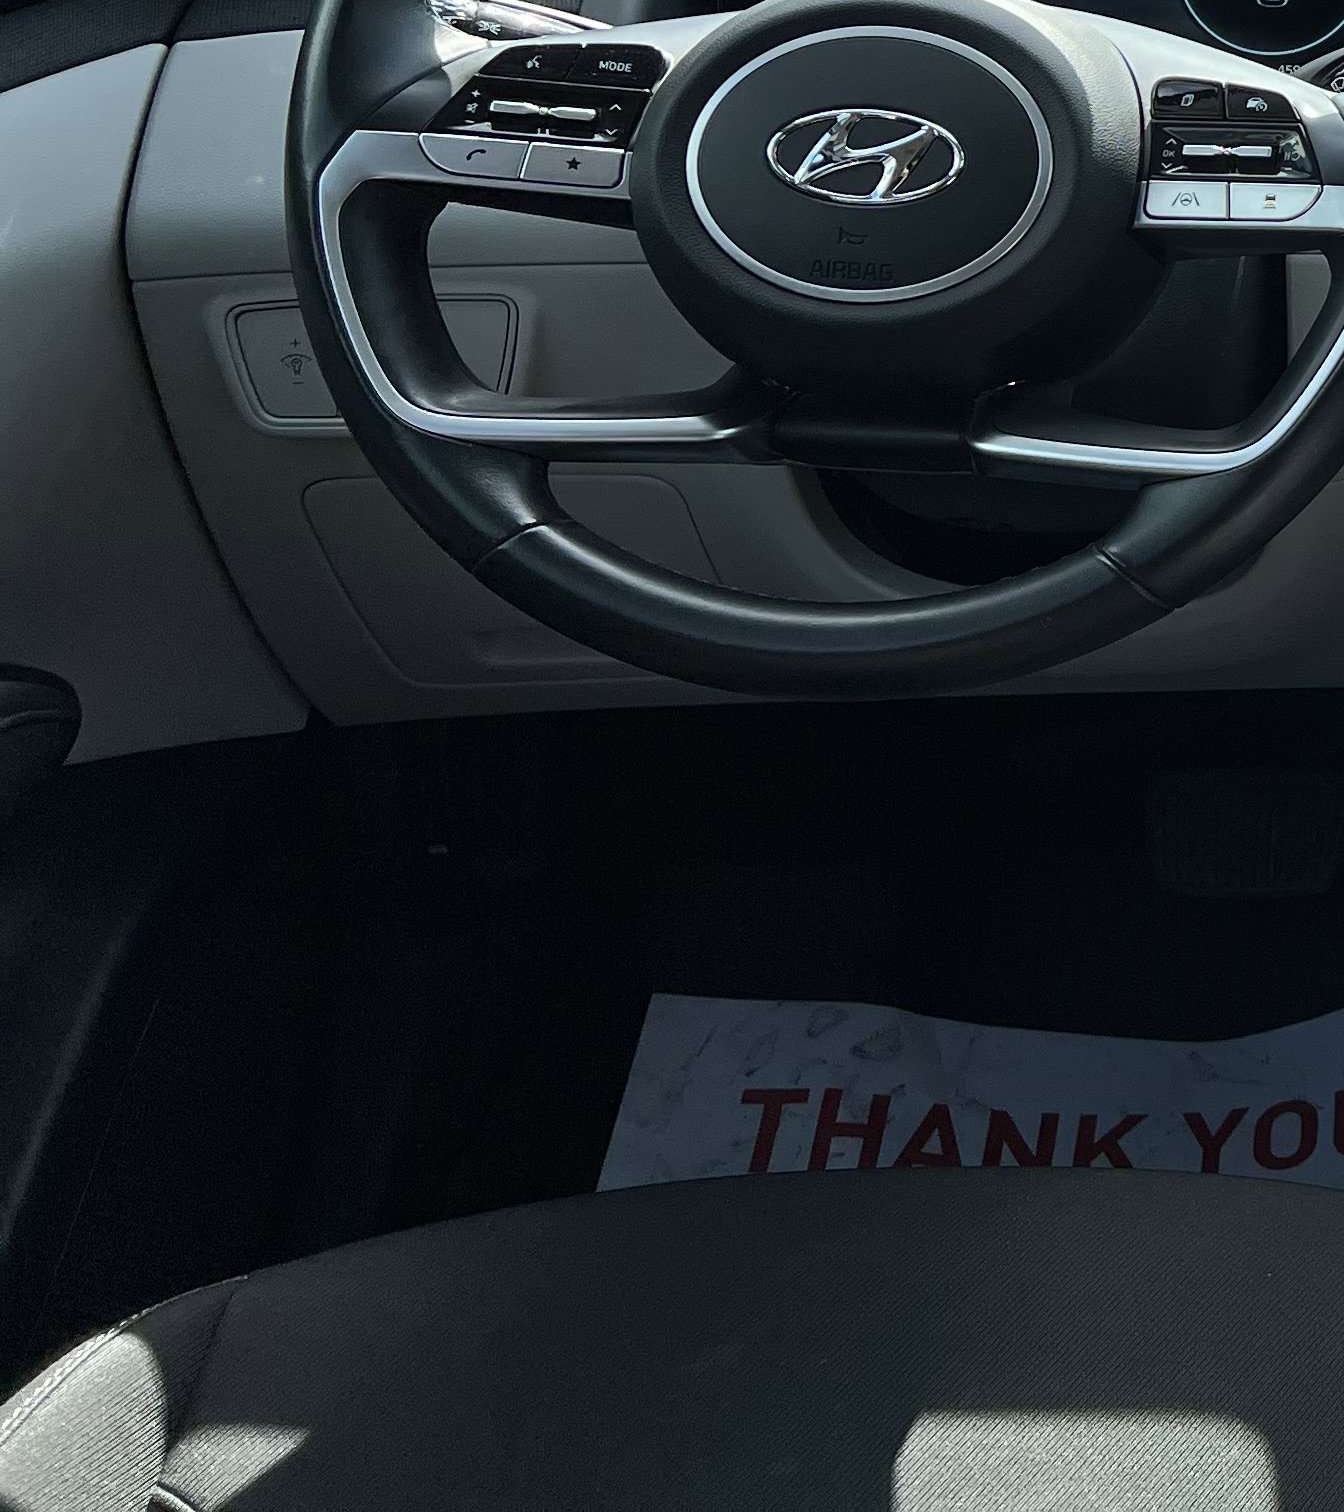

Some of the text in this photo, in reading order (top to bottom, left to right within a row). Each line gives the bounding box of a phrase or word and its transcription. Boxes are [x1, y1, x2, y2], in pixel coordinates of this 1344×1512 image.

[598, 60, 633, 73] MODE
[1162, 149, 1175, 158] OK
[809, 259, 894, 283] AIRBAG
[740, 1088, 1149, 1173] THANK
